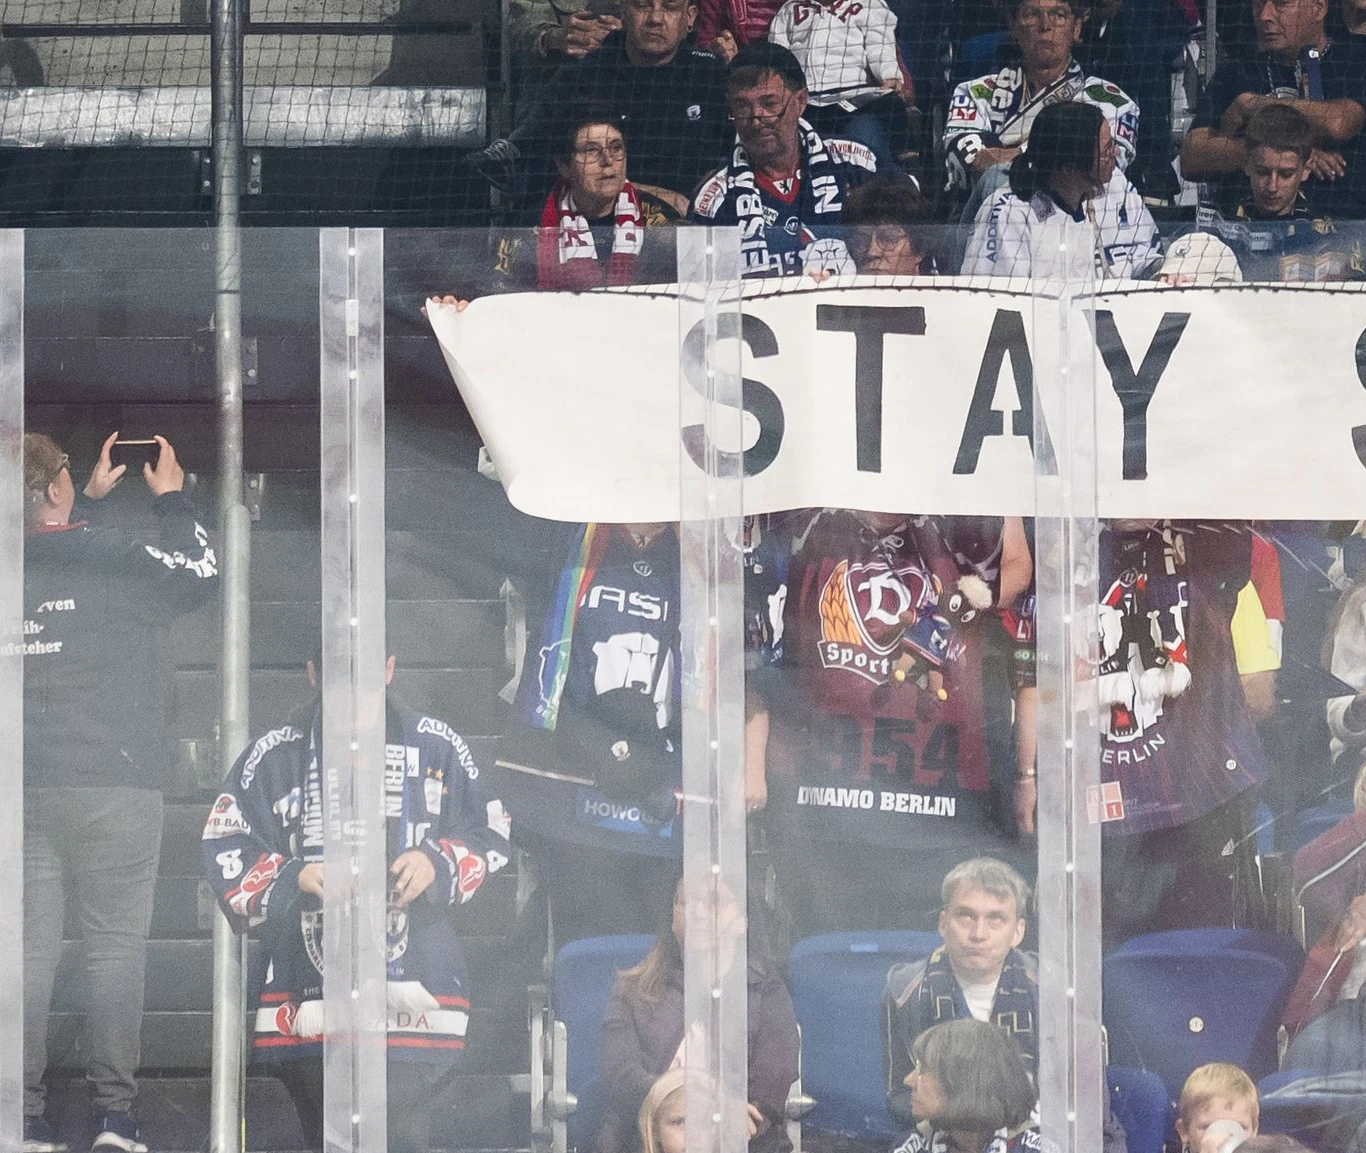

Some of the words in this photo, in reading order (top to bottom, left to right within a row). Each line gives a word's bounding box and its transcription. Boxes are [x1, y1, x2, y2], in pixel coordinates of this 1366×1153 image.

[680, 305, 1190, 481] STAY
[797, 784, 875, 811] DYNAMO
[880, 789, 957, 818] BERLIN
